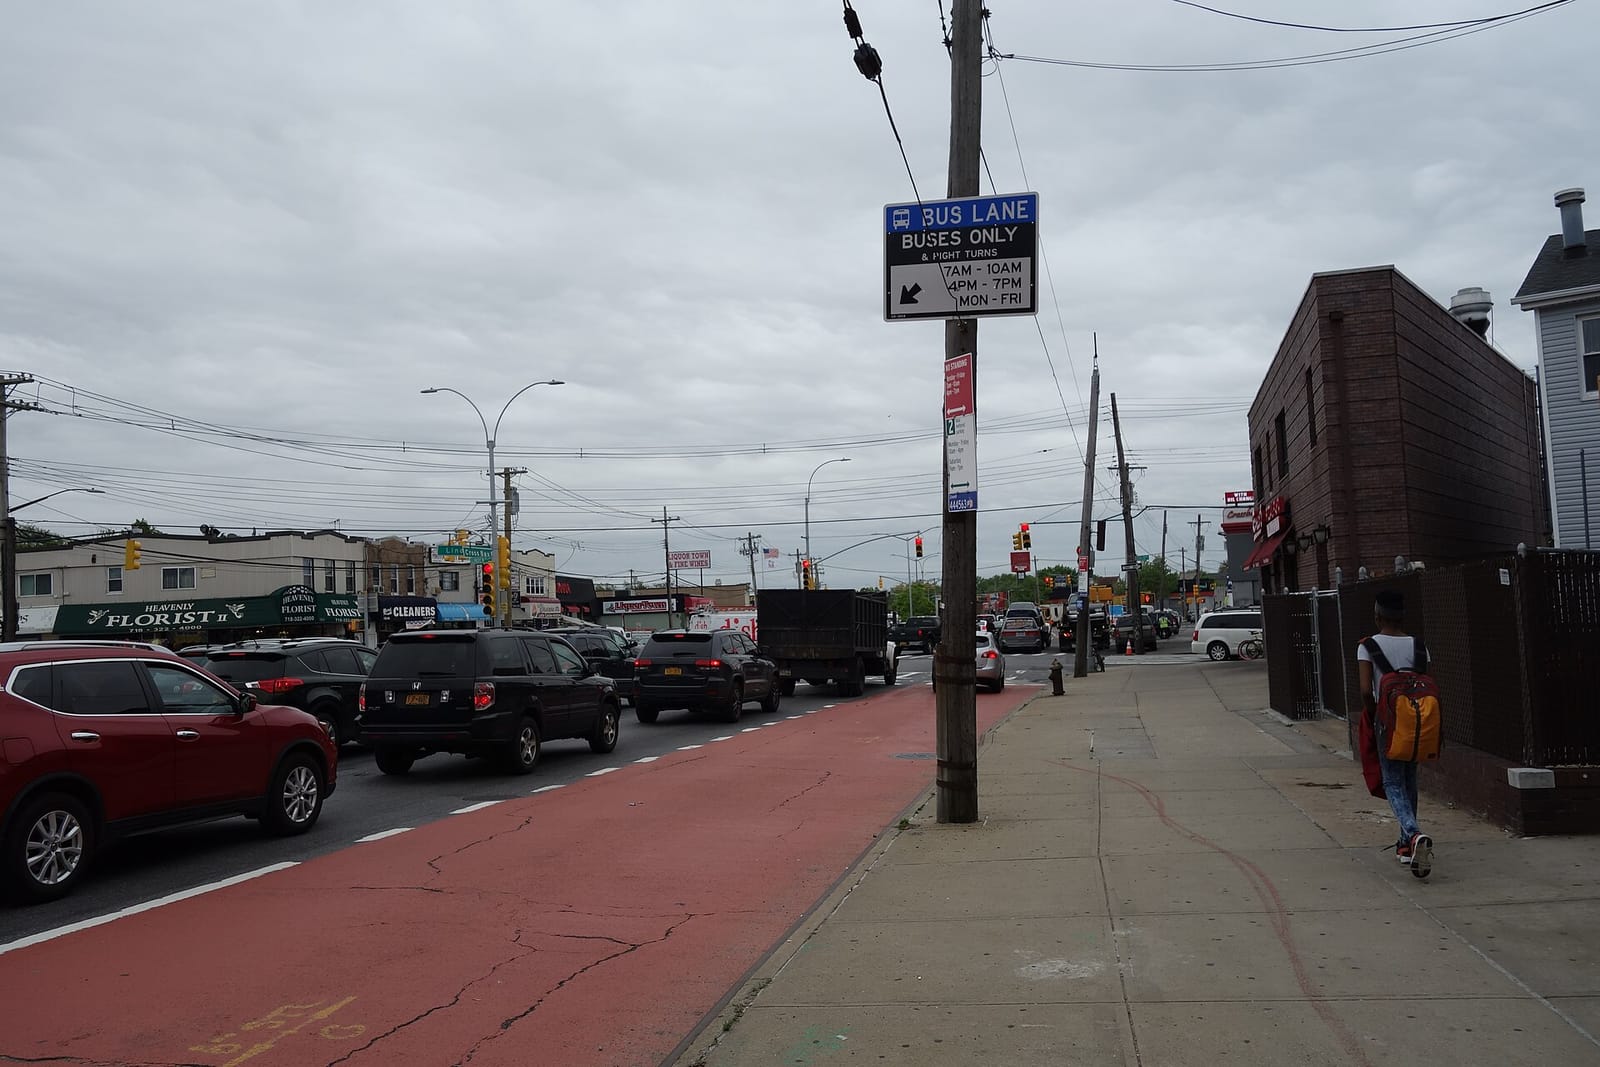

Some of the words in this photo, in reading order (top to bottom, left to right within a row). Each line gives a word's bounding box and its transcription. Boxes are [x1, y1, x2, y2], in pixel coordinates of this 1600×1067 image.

[922, 206, 962, 227] BUS
[973, 200, 1029, 222] LANE
[902, 231, 961, 249] BUSES
[970, 226, 1018, 244] ONLY
[921, 253, 929, 261] &
[965, 249, 998, 258] TURNS
[944, 265, 971, 277] 7AM
[987, 262, 1021, 274] 10AM
[949, 280, 977, 291] 4PM
[993, 278, 1021, 289] 7PM
[960, 295, 988, 307] MON
[1001, 293, 1021, 304] FRI
[949, 420, 954, 434] 2
[669, 553, 690, 561] LIQUOR
[692, 551, 709, 560] TOWN
[282, 594, 315, 605] HEAVENLY
[145, 602, 195, 612] HEAVENLY
[281, 604, 317, 614] FLORIST
[325, 607, 361, 617] FLORIST
[393, 606, 436, 618] CLEANERS
[105, 610, 216, 627] FLORIST
[217, 613, 229, 622] II
